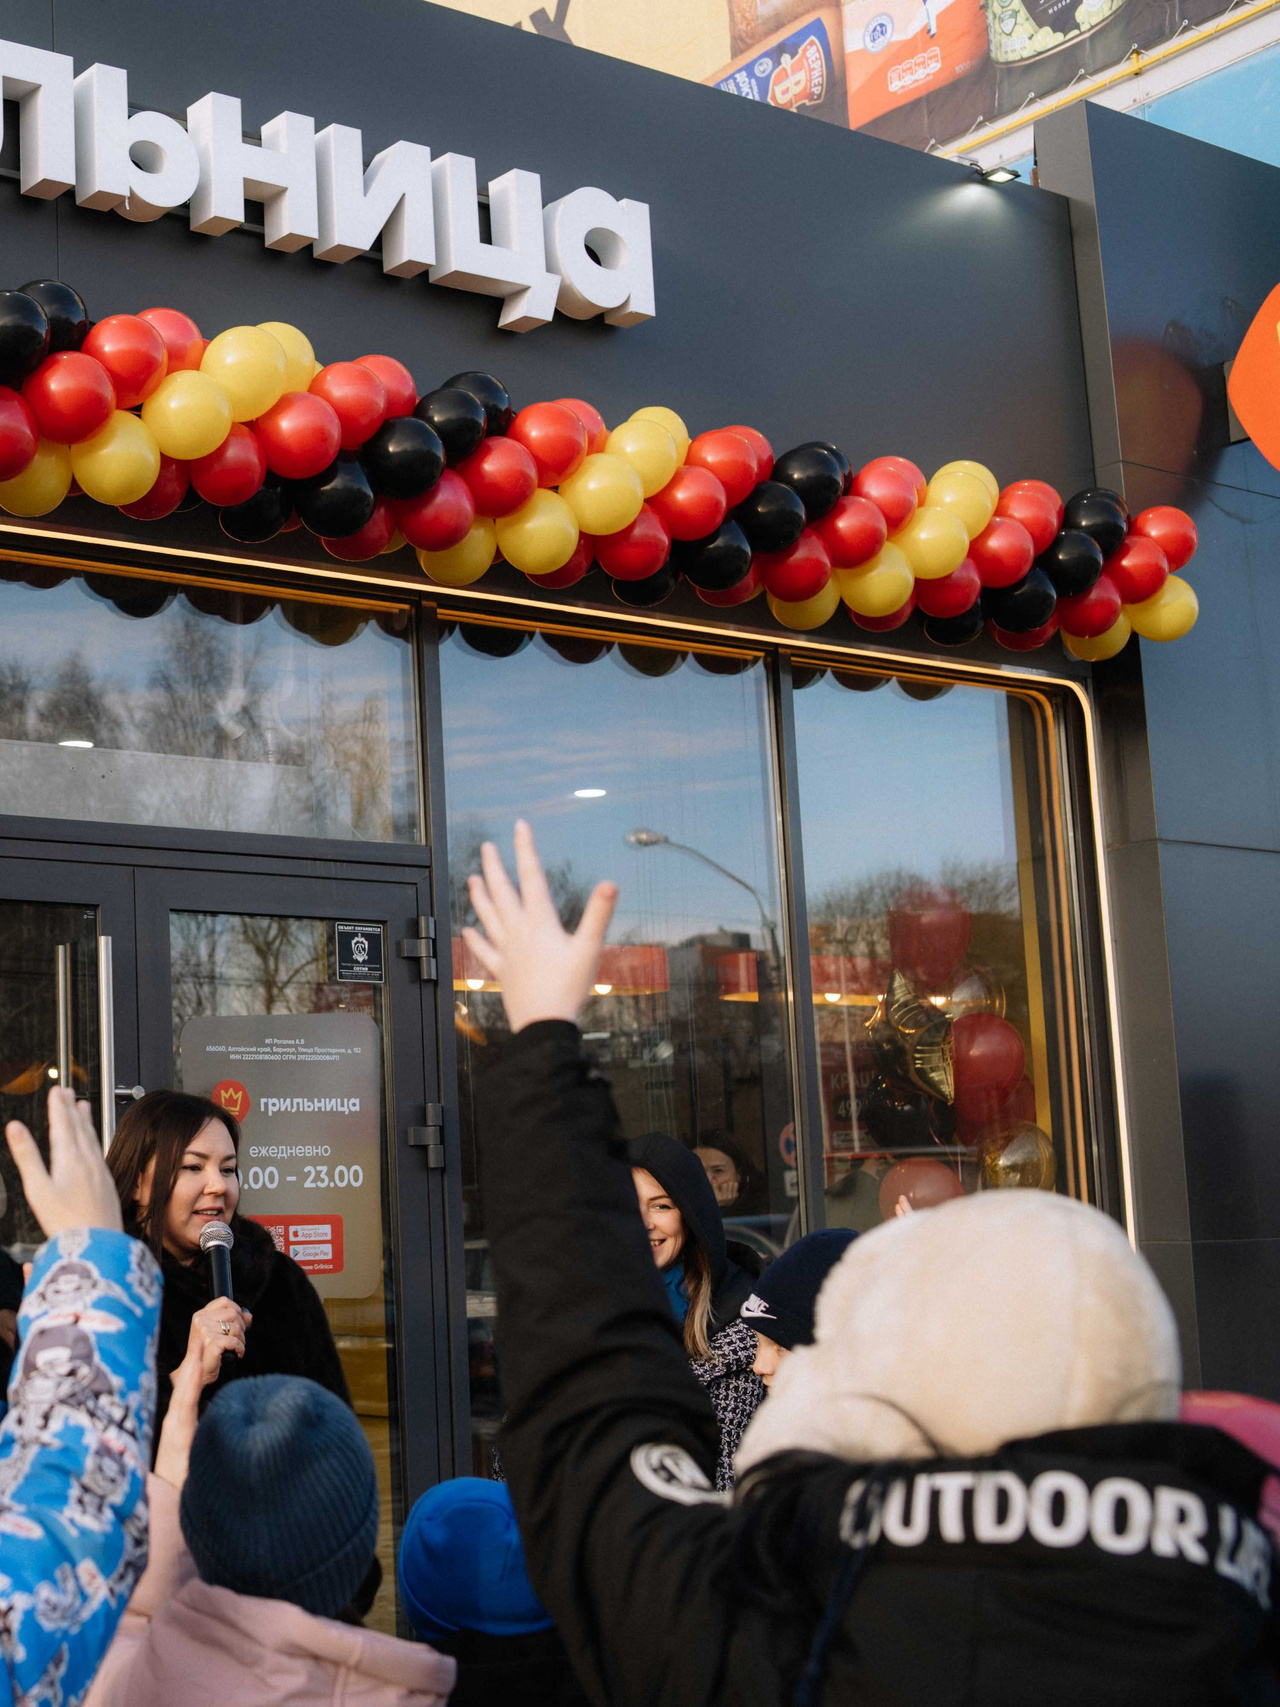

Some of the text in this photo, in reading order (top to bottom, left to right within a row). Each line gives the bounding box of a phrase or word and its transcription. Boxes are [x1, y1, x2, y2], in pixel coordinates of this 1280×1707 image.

[260, 1097, 360, 1117] грильница
[249, 1145, 331, 1159] ежедневно
[303, 1165, 363, 1188] 23.00
[301, 1231, 312, 1239] App
[302, 1250, 319, 1258] Google
